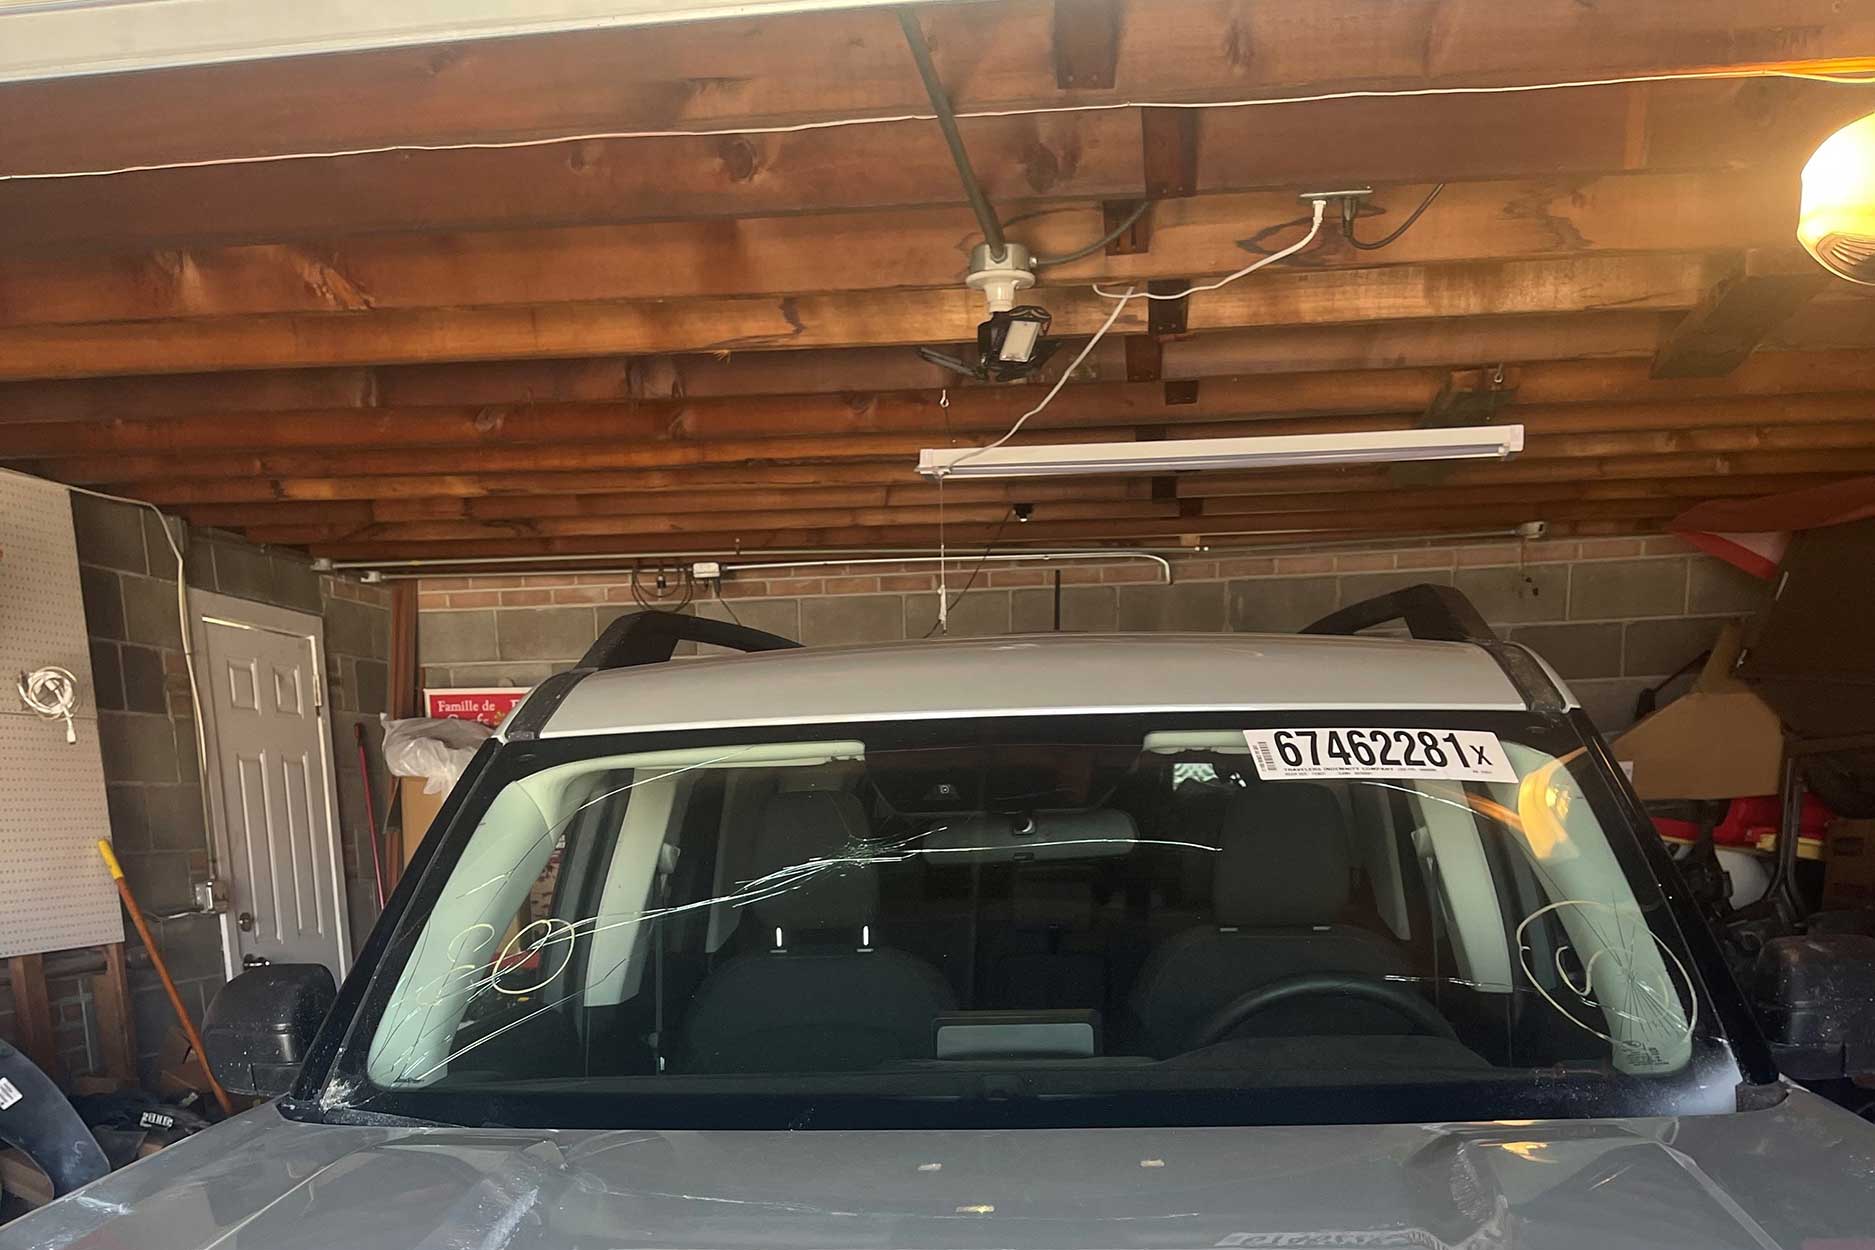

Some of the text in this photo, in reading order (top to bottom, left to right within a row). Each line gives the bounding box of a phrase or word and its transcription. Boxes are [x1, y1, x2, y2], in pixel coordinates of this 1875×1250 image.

[437, 700, 479, 713] Famille
[482, 700, 496, 712] de
[1274, 730, 1471, 768] 67462281
